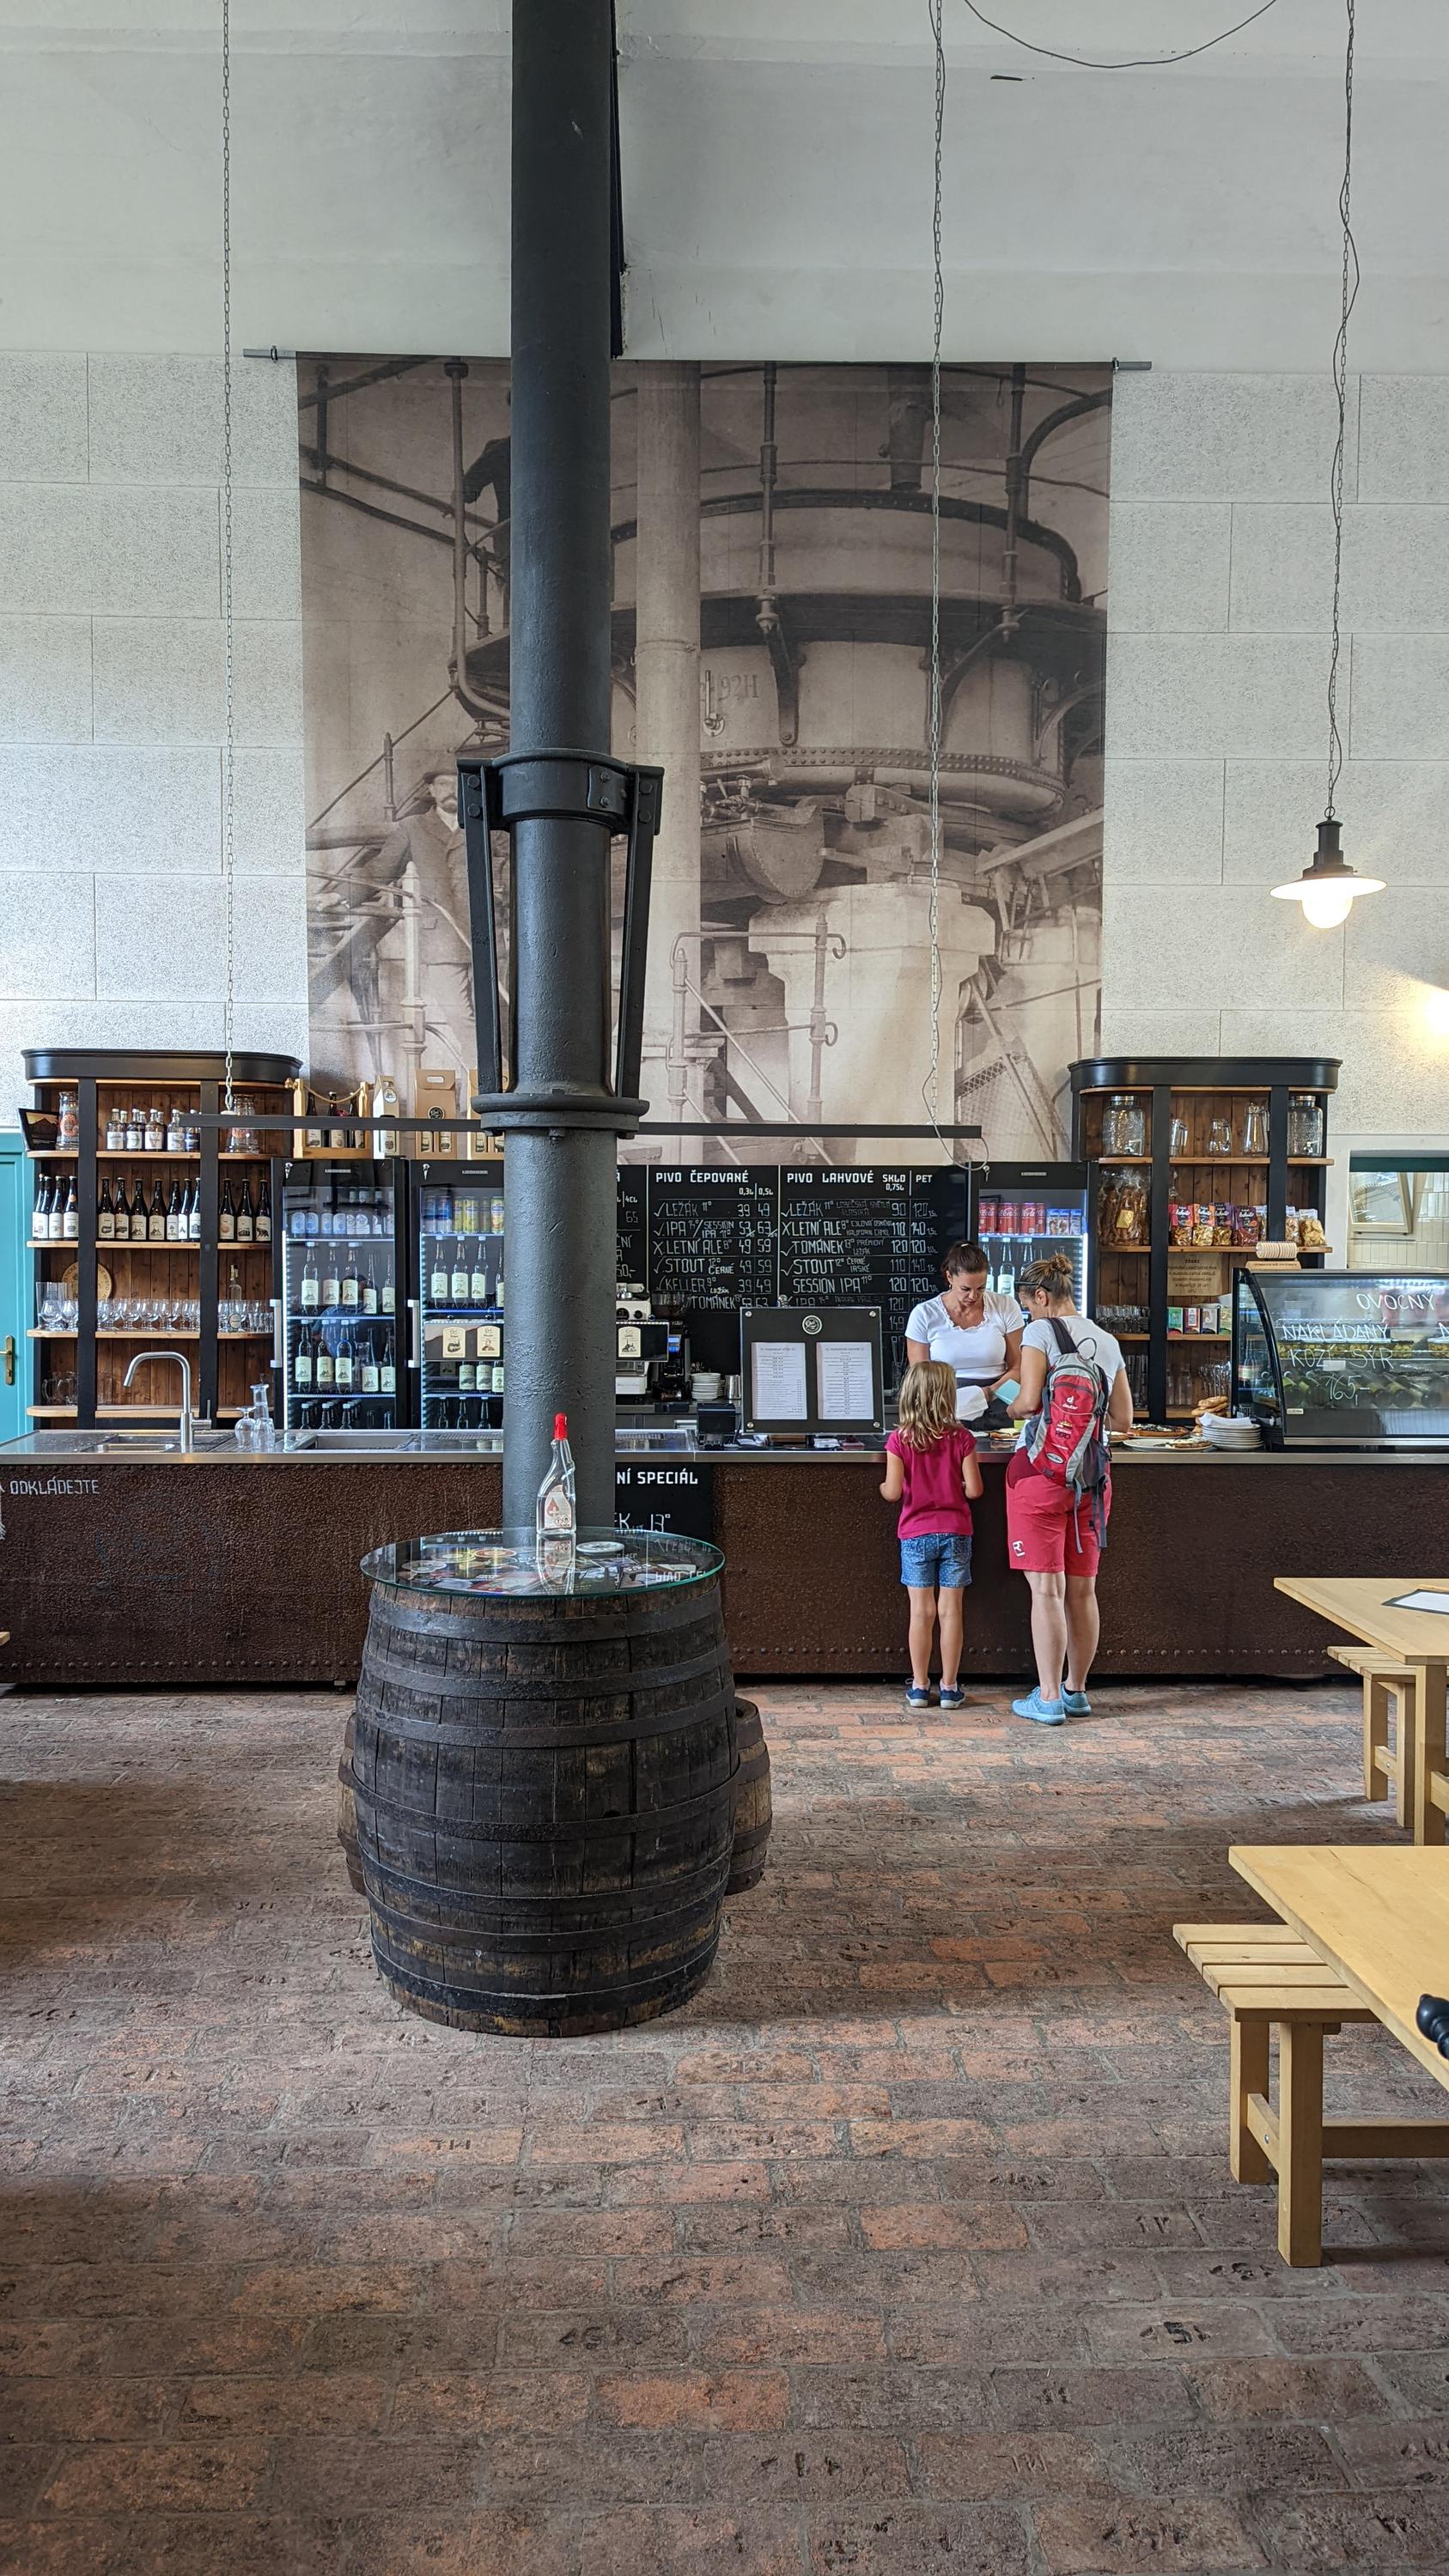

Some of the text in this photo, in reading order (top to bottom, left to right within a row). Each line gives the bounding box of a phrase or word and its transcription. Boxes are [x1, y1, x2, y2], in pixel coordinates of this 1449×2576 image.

[655, 1170, 749, 1182] PIVO ČEPOVANÉ
[787, 1170, 933, 1183] PIVO LAHVOVÉ SKLO PET
[666, 1200, 698, 1217] LEŽÁK
[737, 1204, 751, 1217] 39
[758, 1203, 770, 1217] 49
[789, 1201, 824, 1217] LEŽÁK
[892, 1202, 906, 1216] 90
[912, 1202, 928, 1217] 120
[625, 1211, 638, 1224] 65
[667, 1221, 686, 1236] IPA
[703, 1220, 734, 1229] SESSION
[702, 1230, 716, 1238] IPA
[792, 1219, 822, 1236] LETNÍ
[824, 1220, 842, 1236] ALE
[892, 1222, 906, 1236] 110
[911, 1222, 926, 1236] 140
[667, 1238, 700, 1255] LETNÍ
[703, 1240, 723, 1255] ALE
[739, 1240, 751, 1254] 49
[758, 1239, 771, 1253] 59
[792, 1239, 844, 1255] TOMÁNEK
[891, 1240, 908, 1254] 120
[910, 1240, 926, 1254] 120
[665, 1259, 705, 1273] STOUT
[740, 1261, 752, 1273] 49
[758, 1260, 772, 1273] 59
[793, 1259, 835, 1274] STOUT
[890, 1259, 905, 1273] 110
[911, 1259, 926, 1273] 140
[666, 1279, 707, 1292] KELLER
[738, 1279, 752, 1293] 39
[756, 1279, 771, 1293] 49
[793, 1278, 836, 1294] SESSION
[840, 1278, 861, 1293] IPA
[889, 1277, 907, 1292] 120
[910, 1277, 928, 1292] 120
[691, 1294, 736, 1309] TOMÁNEK
[888, 1297, 904, 1311] 120
[1356, 1291, 1436, 1311] OVOCNÝ
[1349, 1345, 1394, 1370] SÝR
[637, 1468, 698, 1485] SPECIÁL
[9, 1475, 100, 1495] ODKLÁDEJTE
